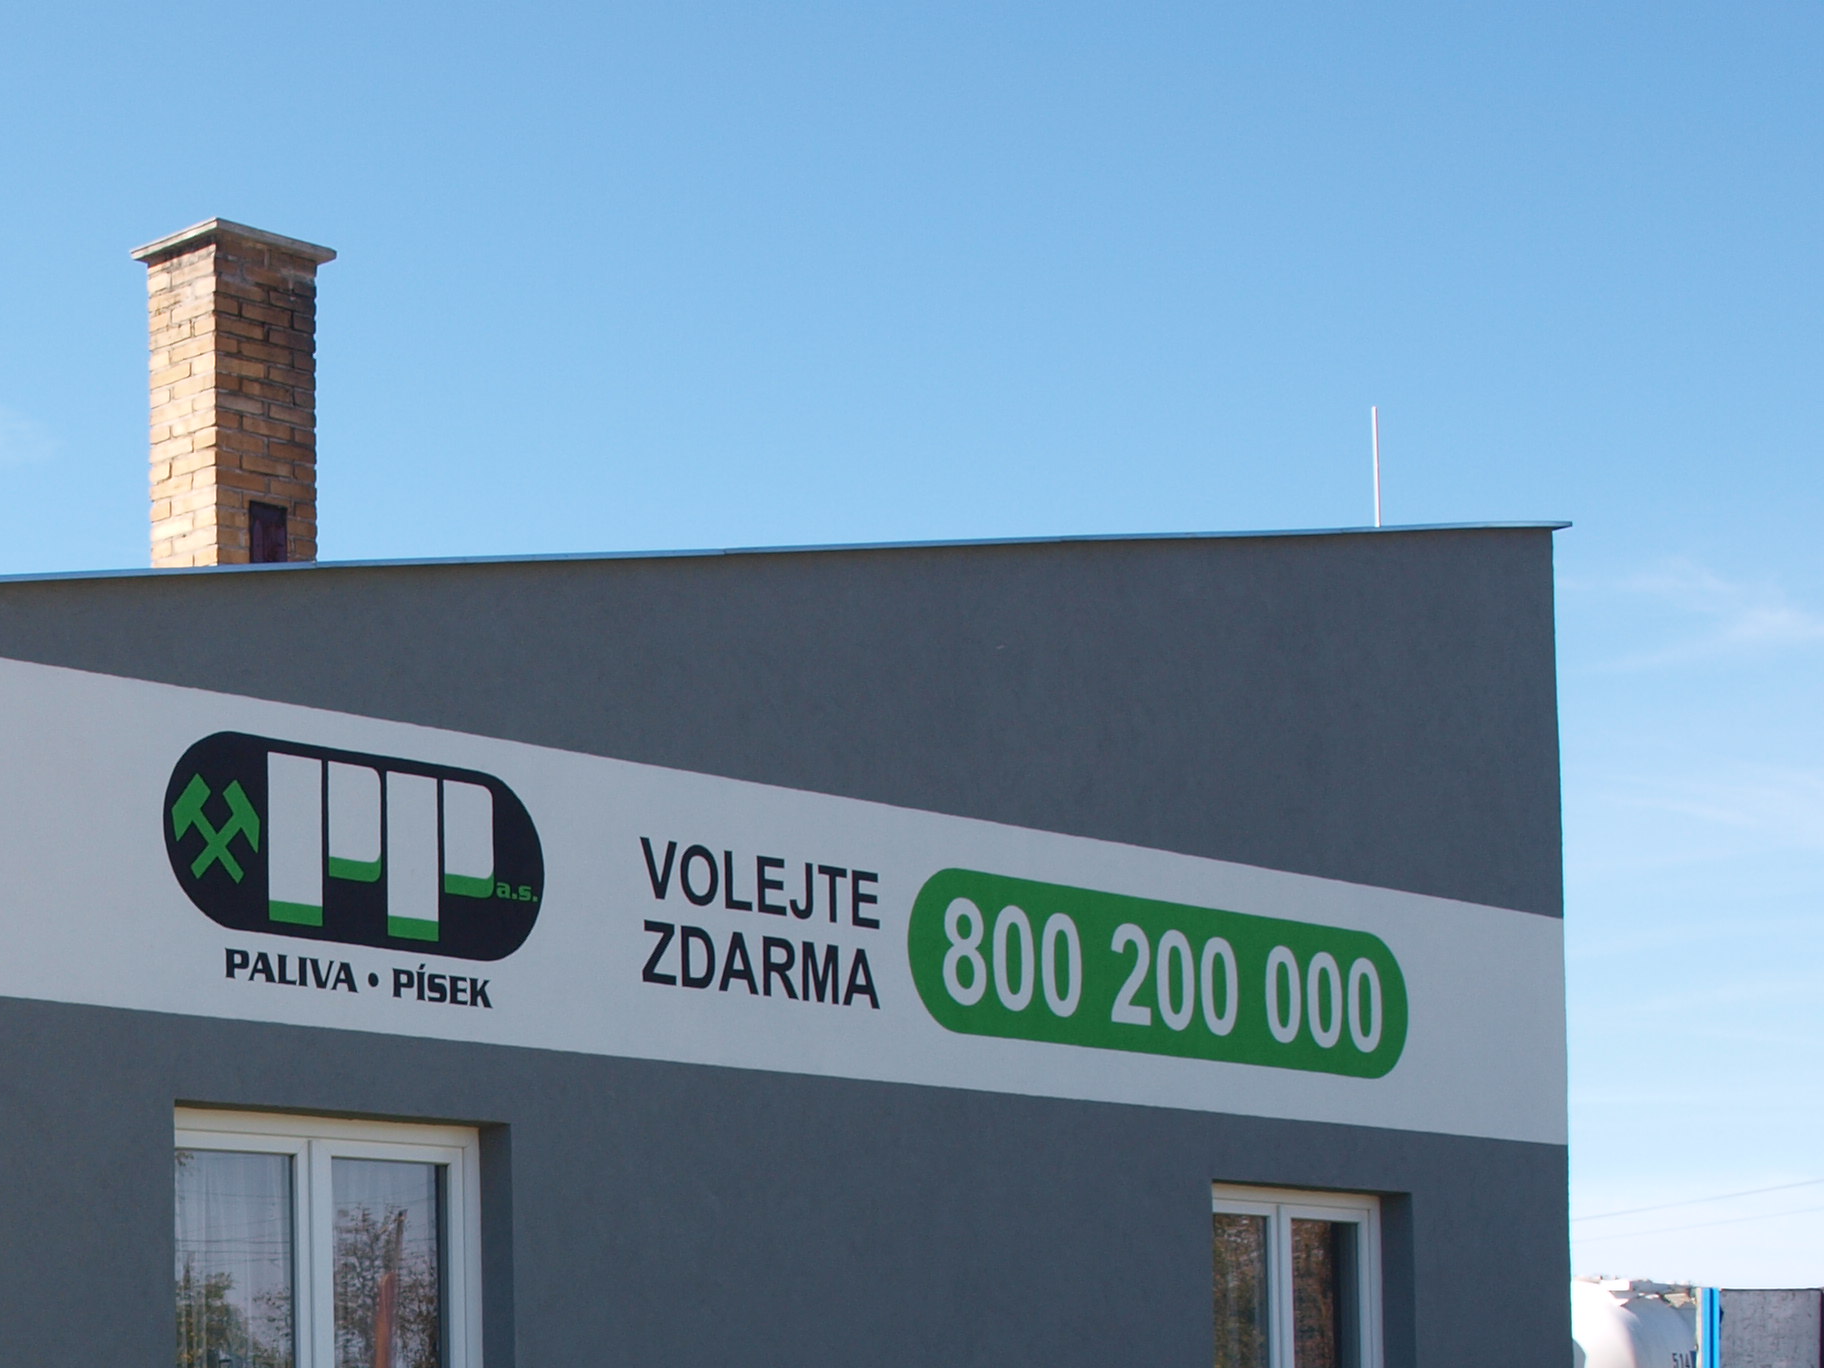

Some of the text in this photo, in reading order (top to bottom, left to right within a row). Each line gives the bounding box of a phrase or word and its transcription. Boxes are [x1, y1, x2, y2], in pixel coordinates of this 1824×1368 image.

[495, 878, 539, 903] a.s.
[639, 836, 881, 930] VOLEJTE
[224, 947, 493, 1010] PALIVA PÍSEK
[642, 919, 881, 1010] ZDARMA
[942, 897, 1383, 1053] 800 200 000
